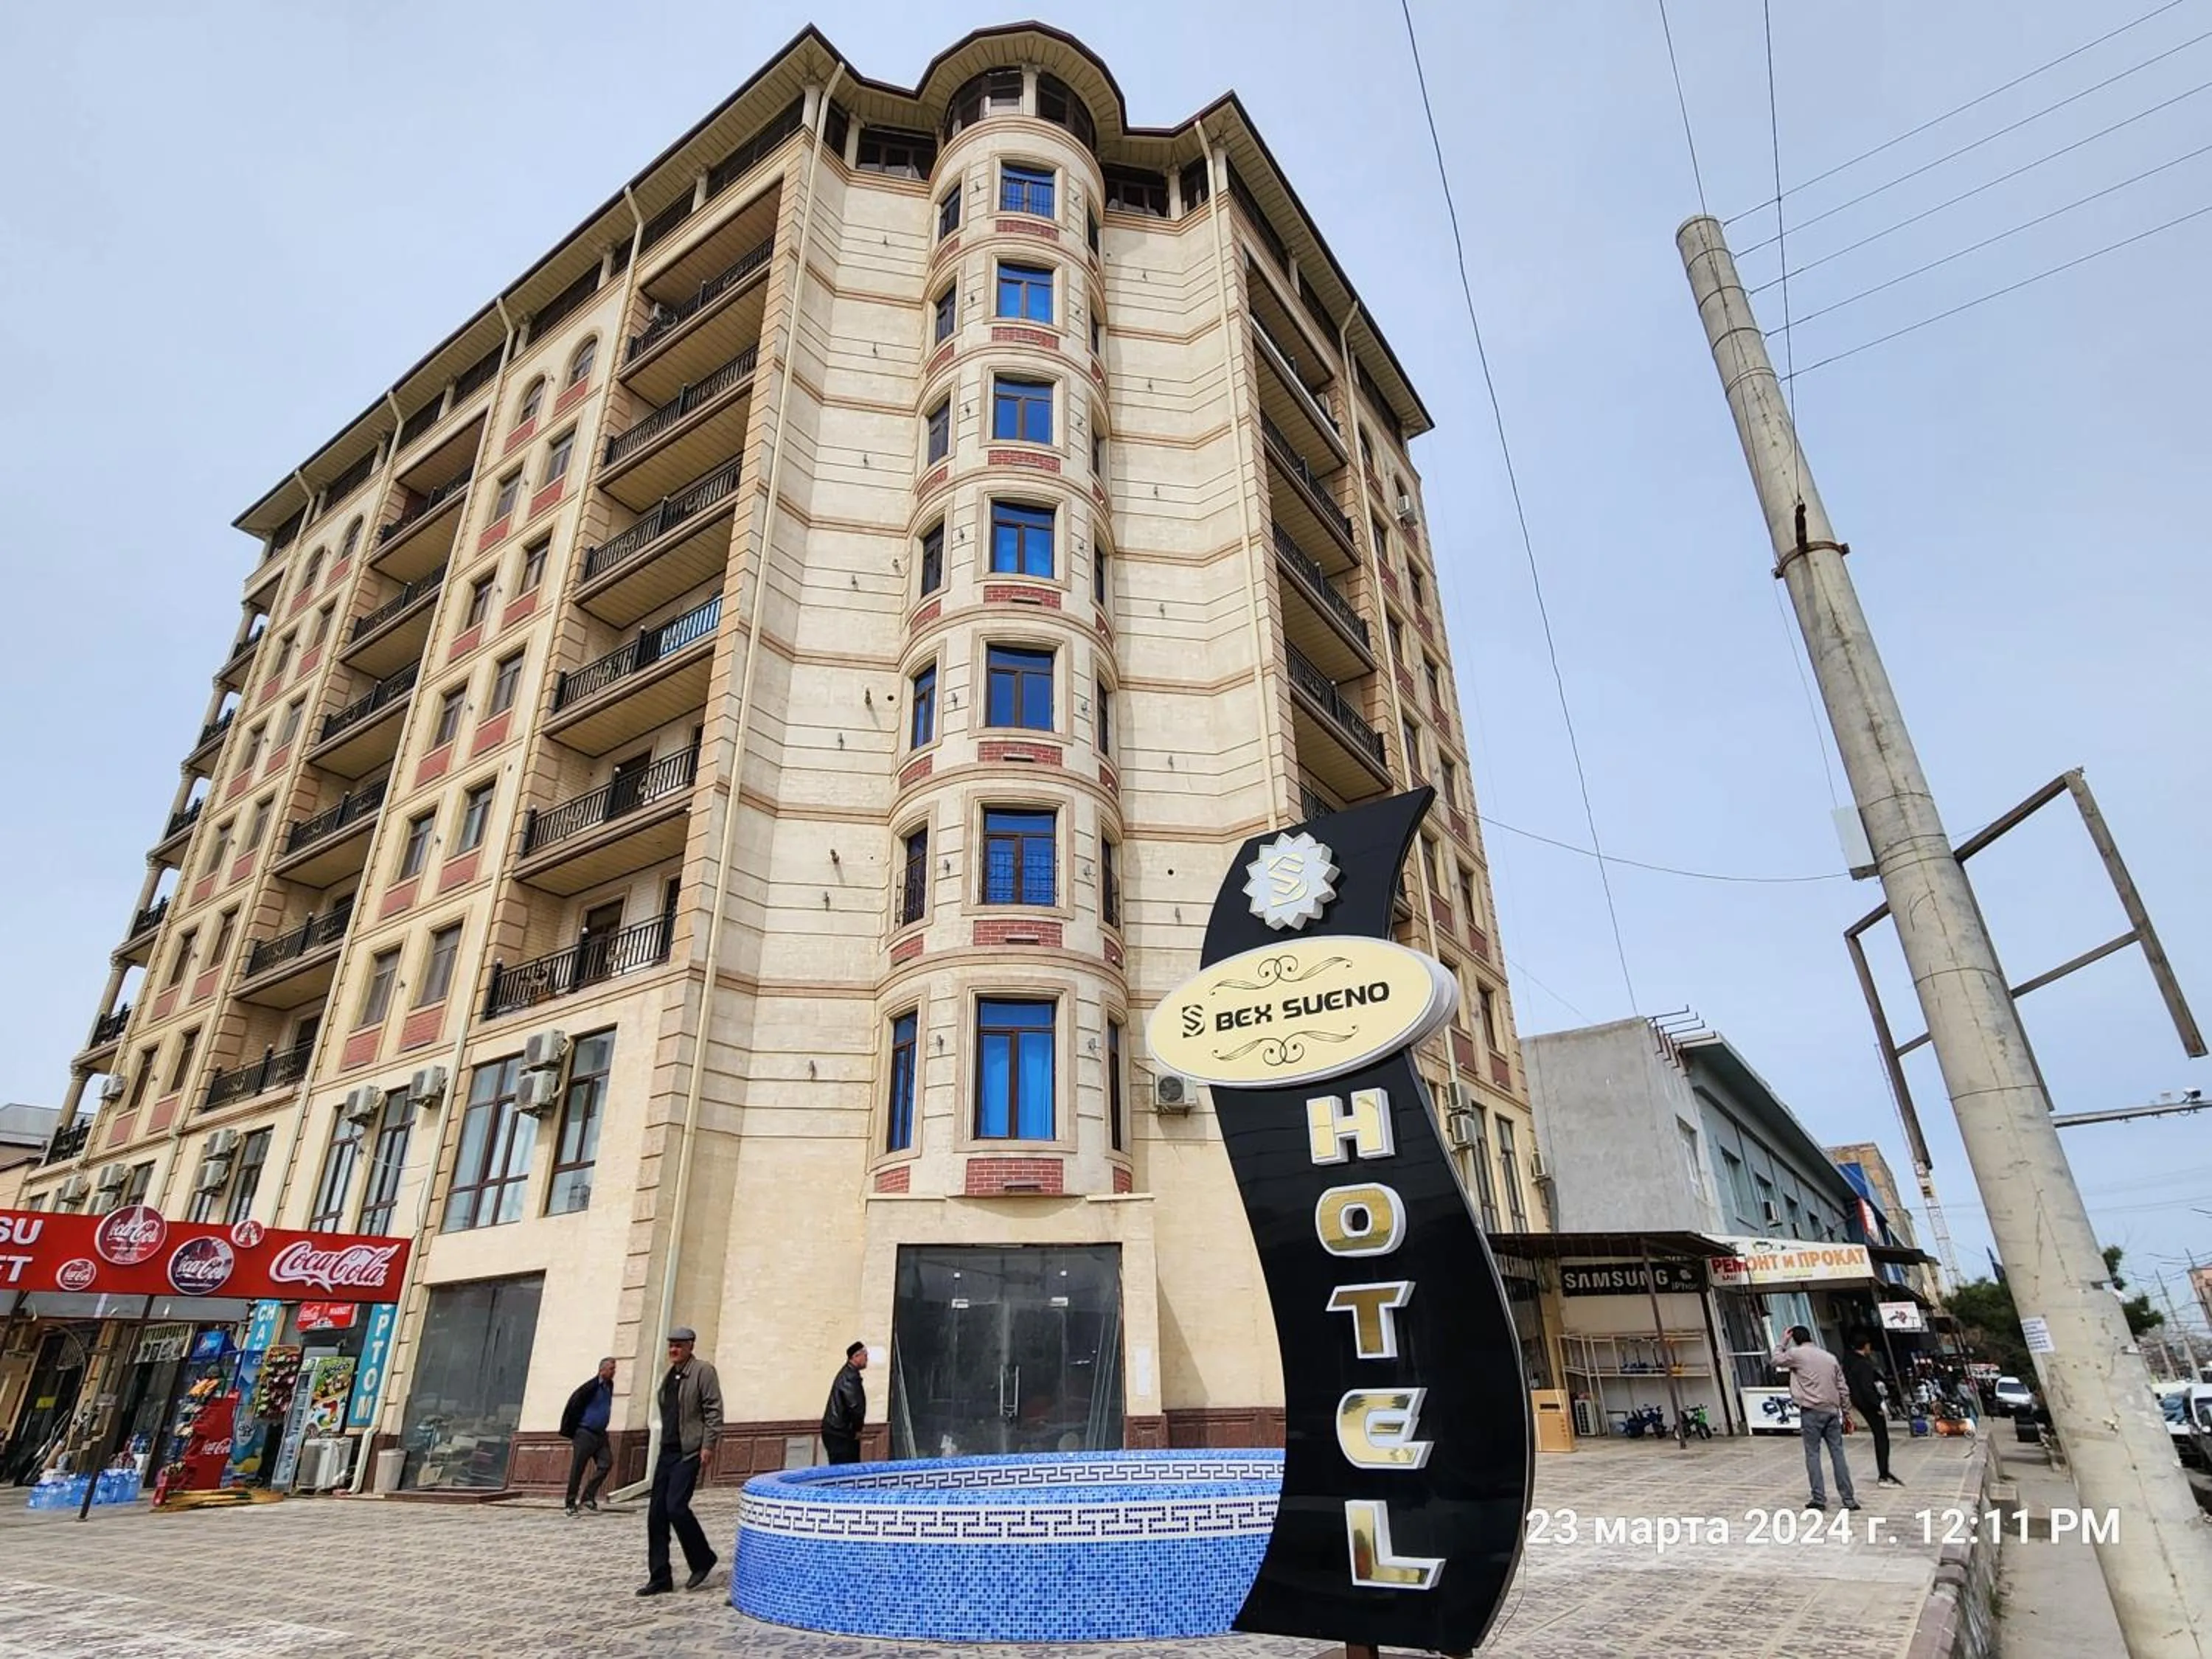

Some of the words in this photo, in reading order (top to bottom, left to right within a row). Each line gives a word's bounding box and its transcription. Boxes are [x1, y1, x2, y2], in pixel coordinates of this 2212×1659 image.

[1215, 1004, 1273, 1032] BEX
[1281, 981, 1390, 1019] SUENO
[0, 1255, 33, 1282] T
[1711, 1254, 1778, 1274] РЕМОНТ
[1797, 1248, 1865, 1267] ПРОКАТ
[1564, 1269, 1669, 1289] SAMSUNG
[1305, 1087, 1447, 1590] HOTEL
